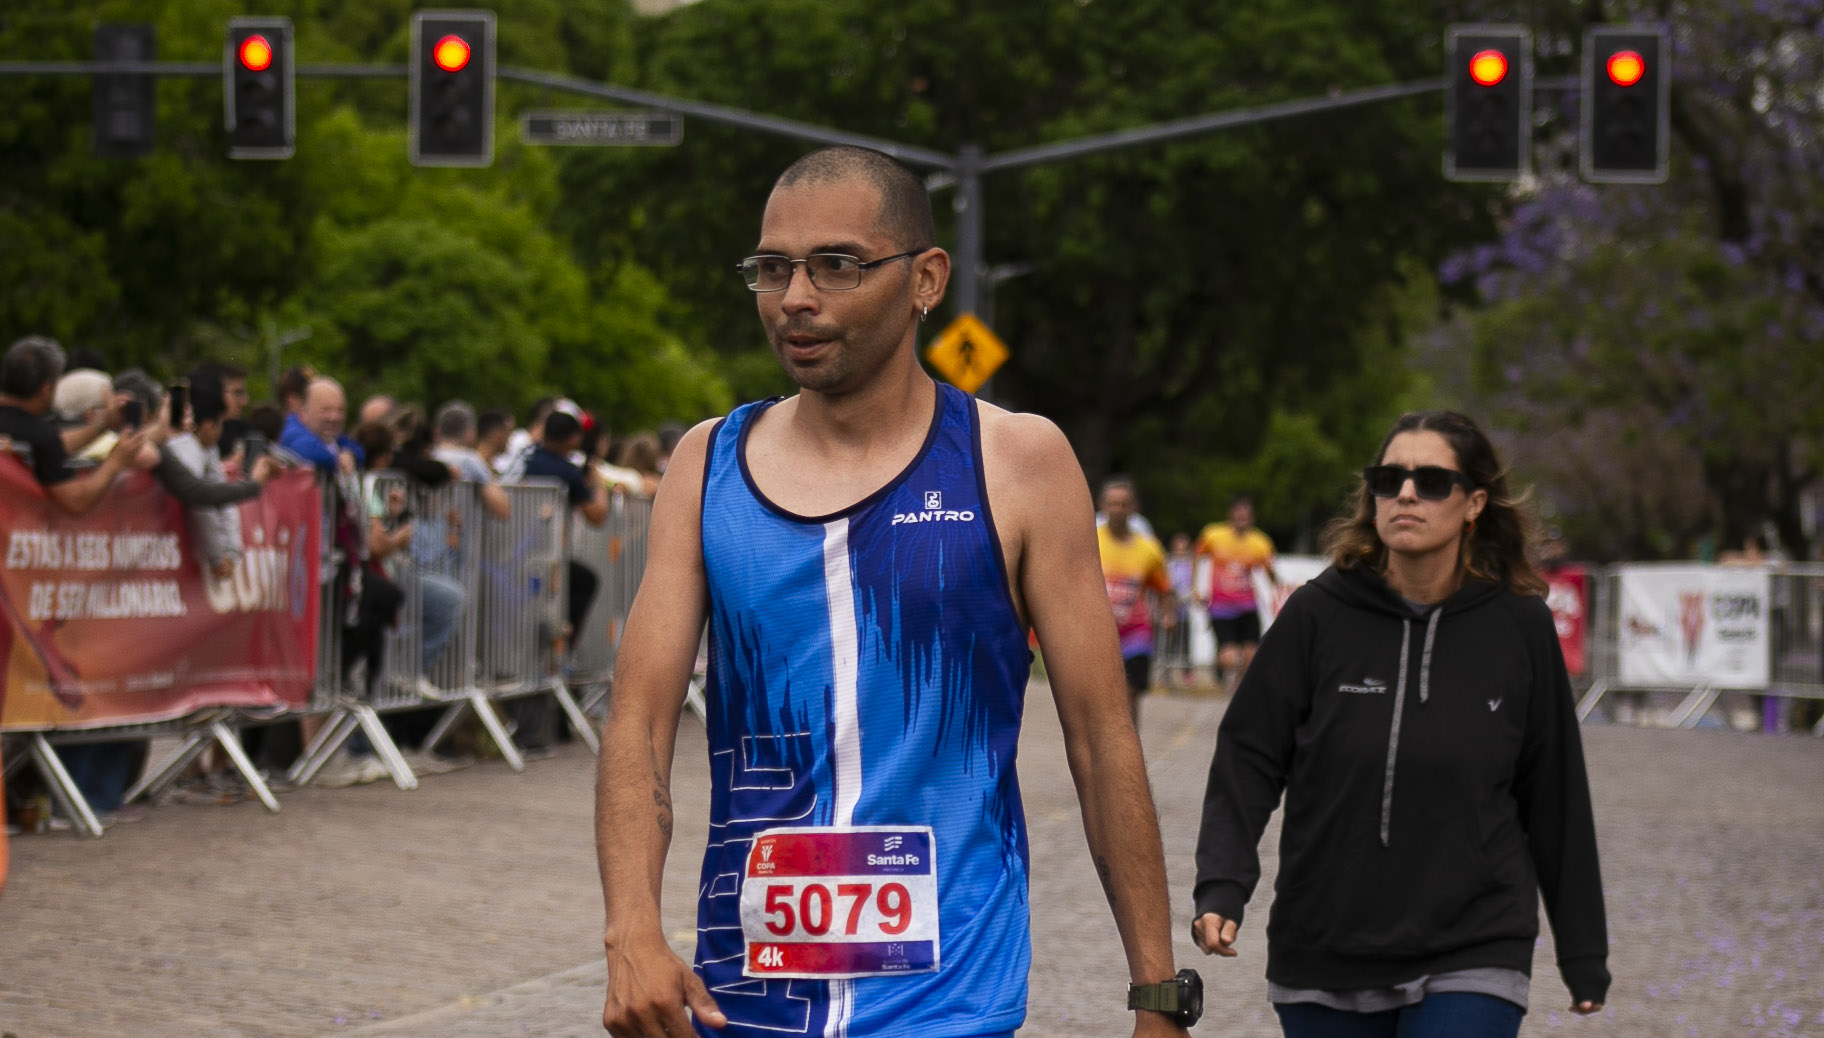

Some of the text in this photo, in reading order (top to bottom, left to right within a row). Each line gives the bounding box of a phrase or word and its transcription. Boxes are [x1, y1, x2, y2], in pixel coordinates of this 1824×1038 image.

[891, 510, 975, 526] PANTRO
[867, 854, 920, 866] Santa Fe
[764, 882, 913, 937] 5079
[757, 946, 784, 967] 4k
